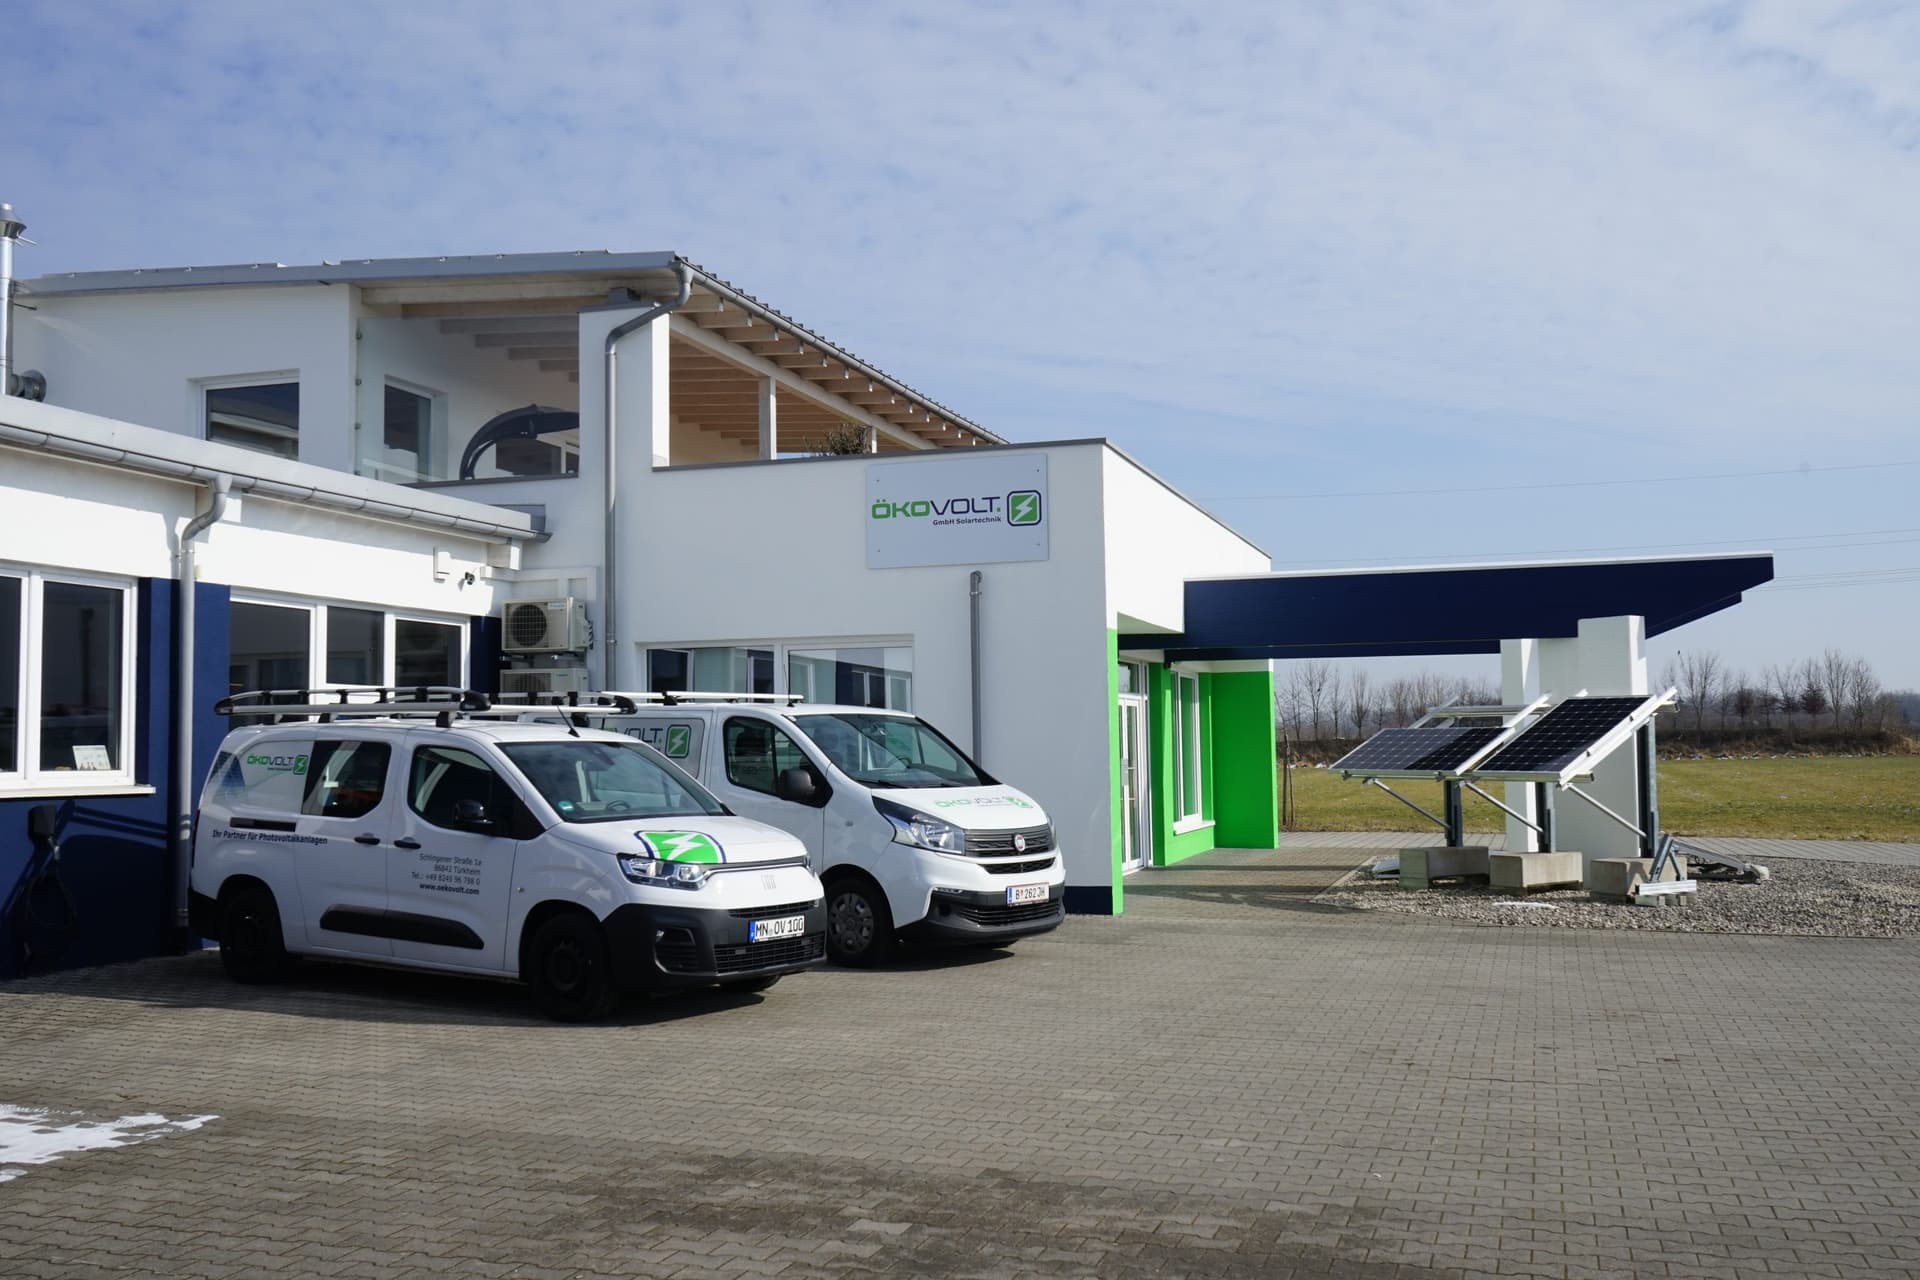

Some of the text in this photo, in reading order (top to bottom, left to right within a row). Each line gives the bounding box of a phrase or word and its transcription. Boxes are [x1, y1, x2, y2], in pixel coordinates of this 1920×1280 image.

[932, 516, 1002, 526] GmbH Solartechnik
[212, 829, 222, 838] Ihr
[223, 830, 247, 840] Partner
[248, 831, 258, 841] für
[755, 917, 804, 937] MN OV 100
